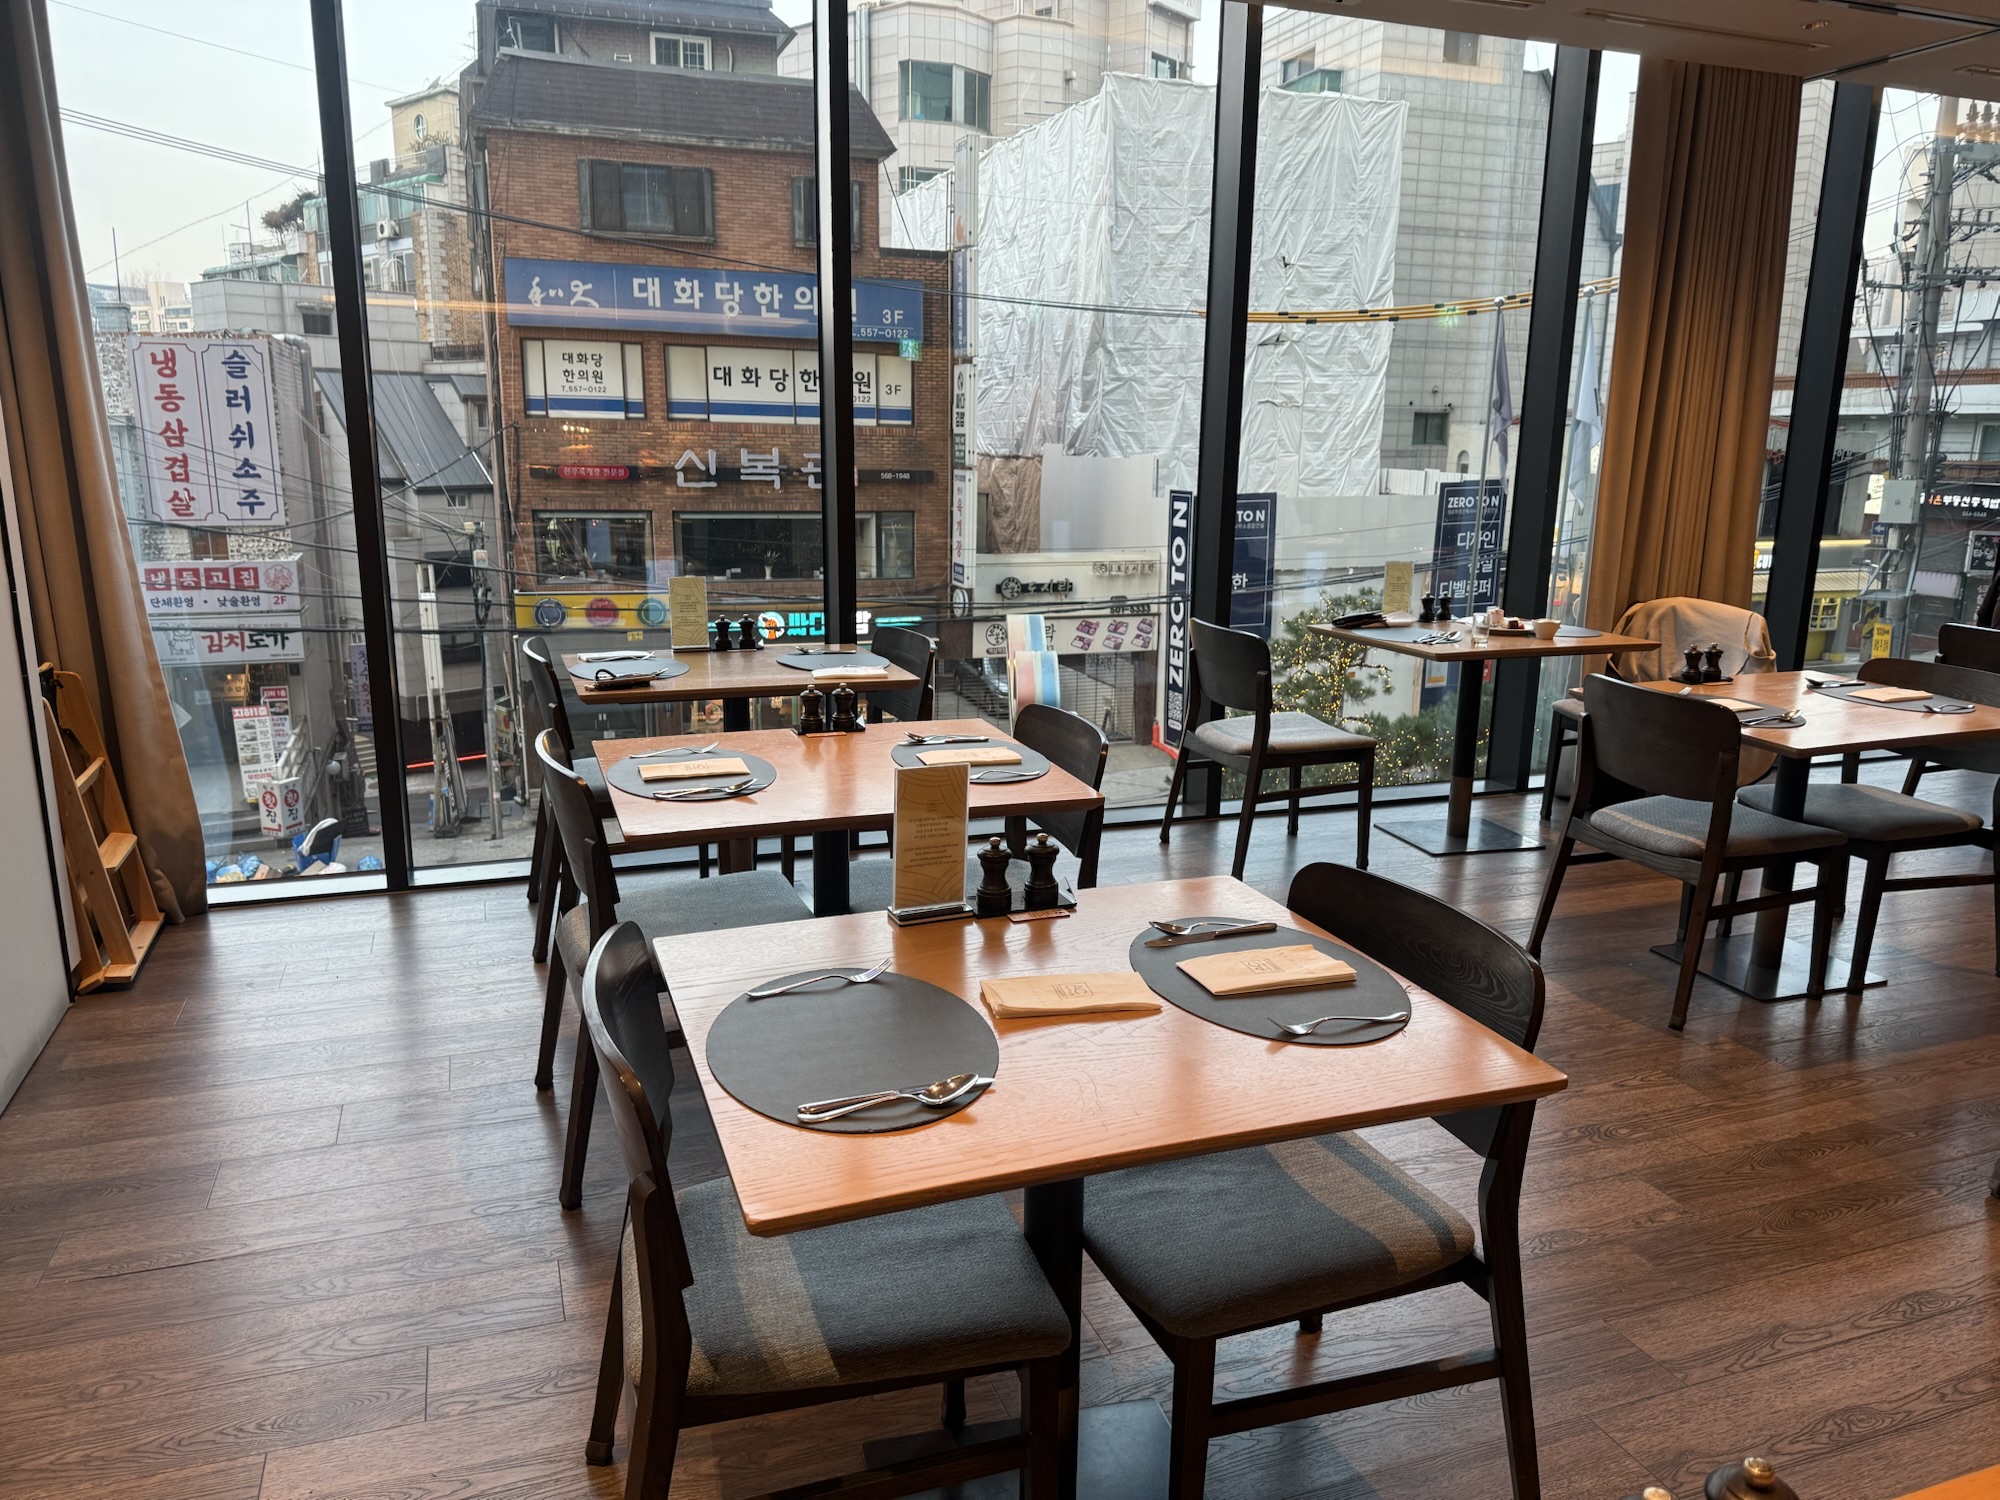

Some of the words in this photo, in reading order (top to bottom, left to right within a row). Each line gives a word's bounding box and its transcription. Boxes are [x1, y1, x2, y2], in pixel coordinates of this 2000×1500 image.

[632, 277, 857, 321] 대화당한의
[882, 309, 904, 324] 3F
[562, 352, 603, 367] 대화당
[562, 368, 603, 384] 한의원
[713, 366, 871, 395] 대화당한원
[561, 385, 607, 393] T.557-0122
[885, 384, 902, 395] 3F
[150, 348, 196, 517] 냉동삼겹살
[221, 350, 266, 516] 슬러쉬소주
[1447, 495, 1474, 509] ZERO
[150, 596, 194, 608] 단체환영
[217, 595, 261, 607] 낮술환영
[273, 595, 287, 605] 2F
[201, 629, 290, 653] 김치도가
